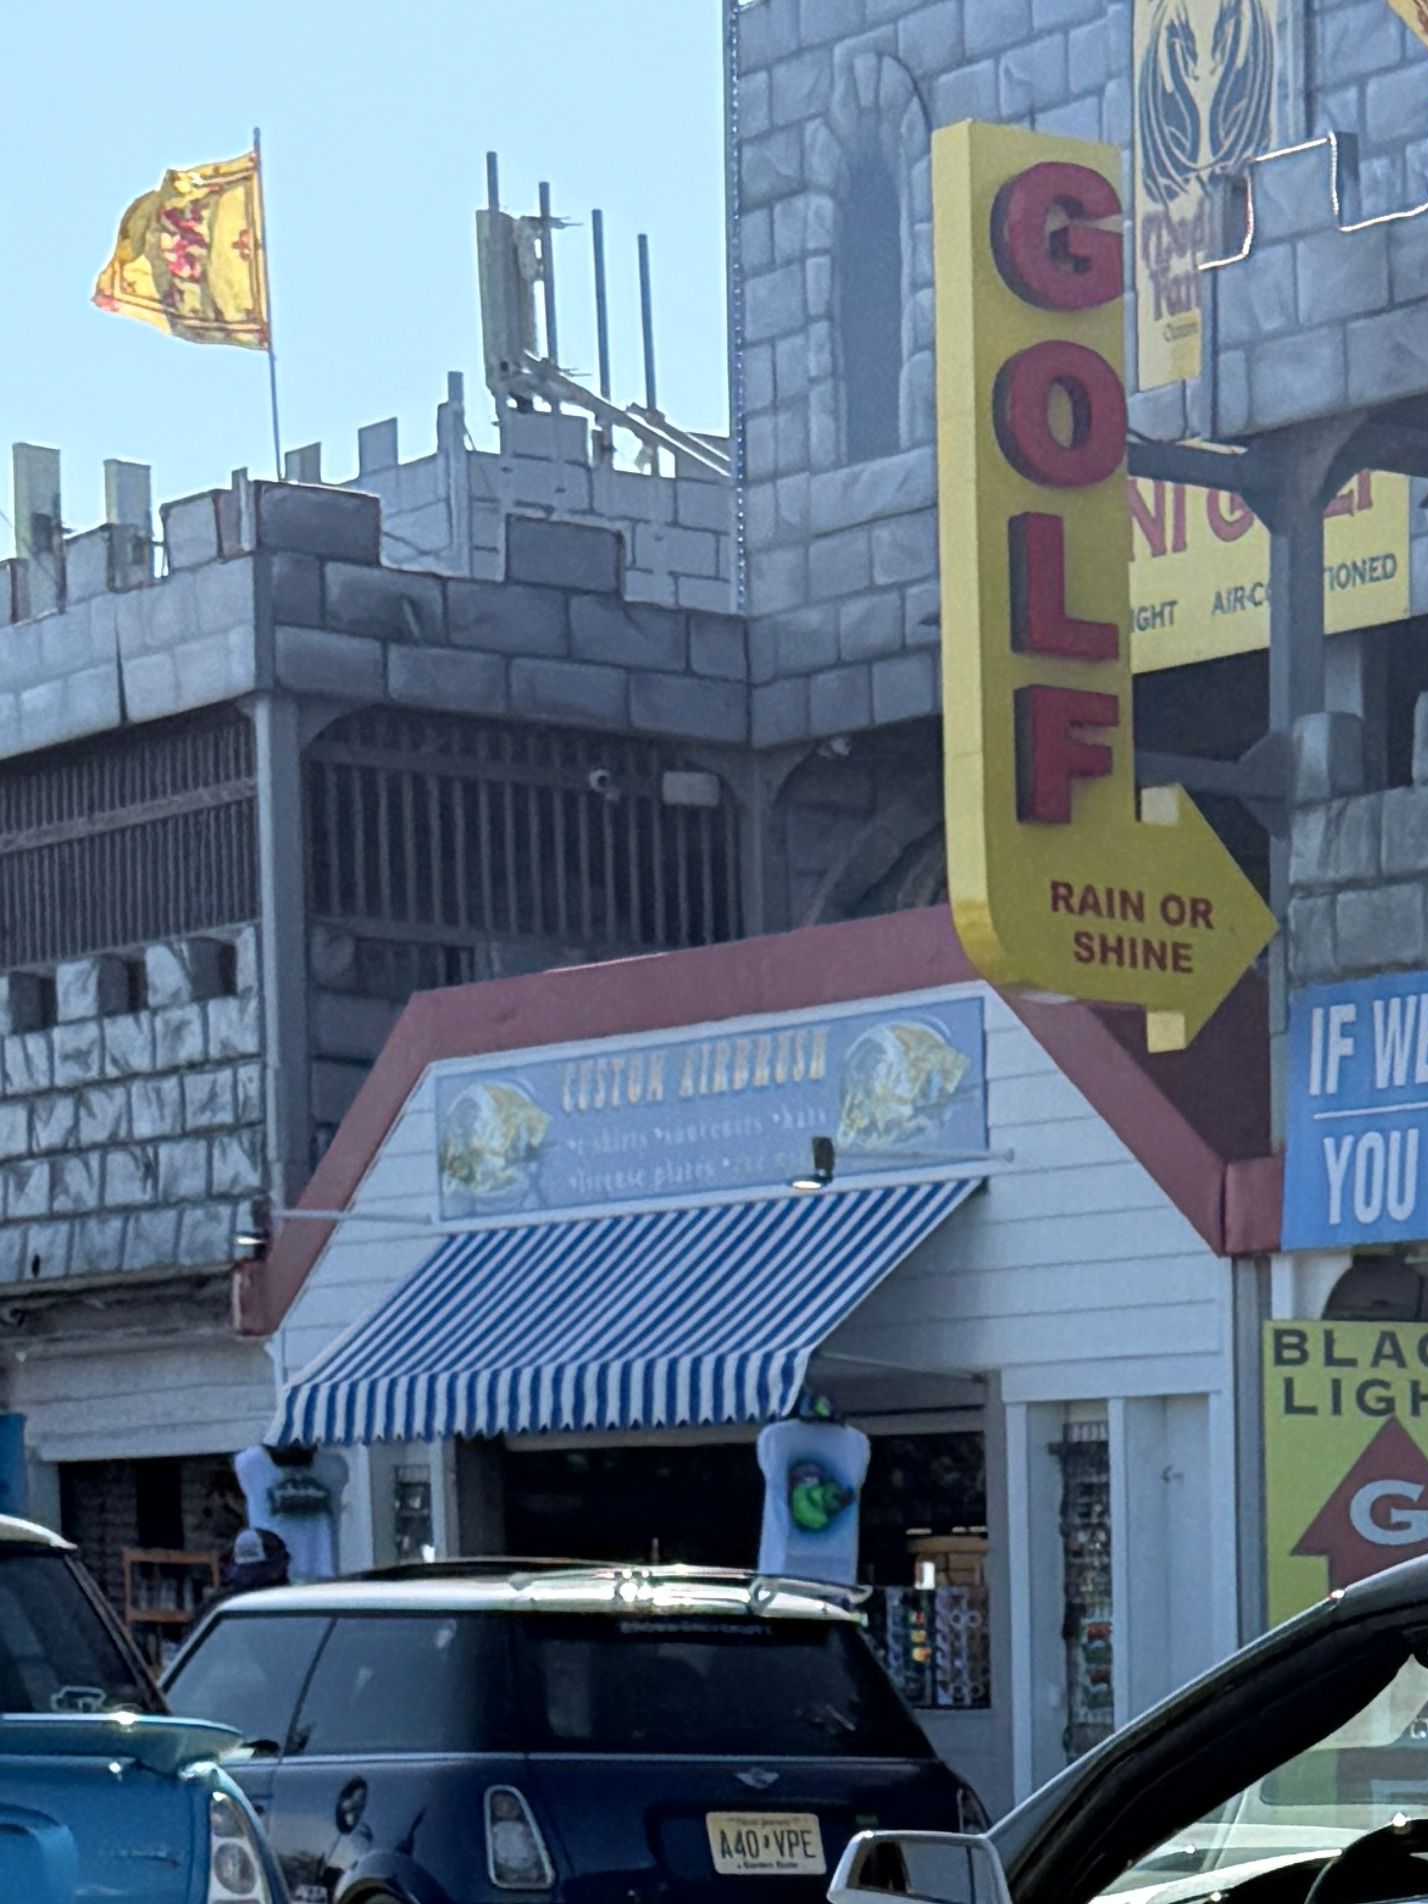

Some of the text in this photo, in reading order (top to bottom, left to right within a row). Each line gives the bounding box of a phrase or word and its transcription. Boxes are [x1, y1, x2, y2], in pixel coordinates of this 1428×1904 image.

[989, 160, 1126, 827] GOLF
[1050, 878, 1215, 930] RAIN OR
[1073, 930, 1194, 975] SHINE
[1308, 1003, 1356, 1097] IF
[1323, 1127, 1420, 1226] YOU
